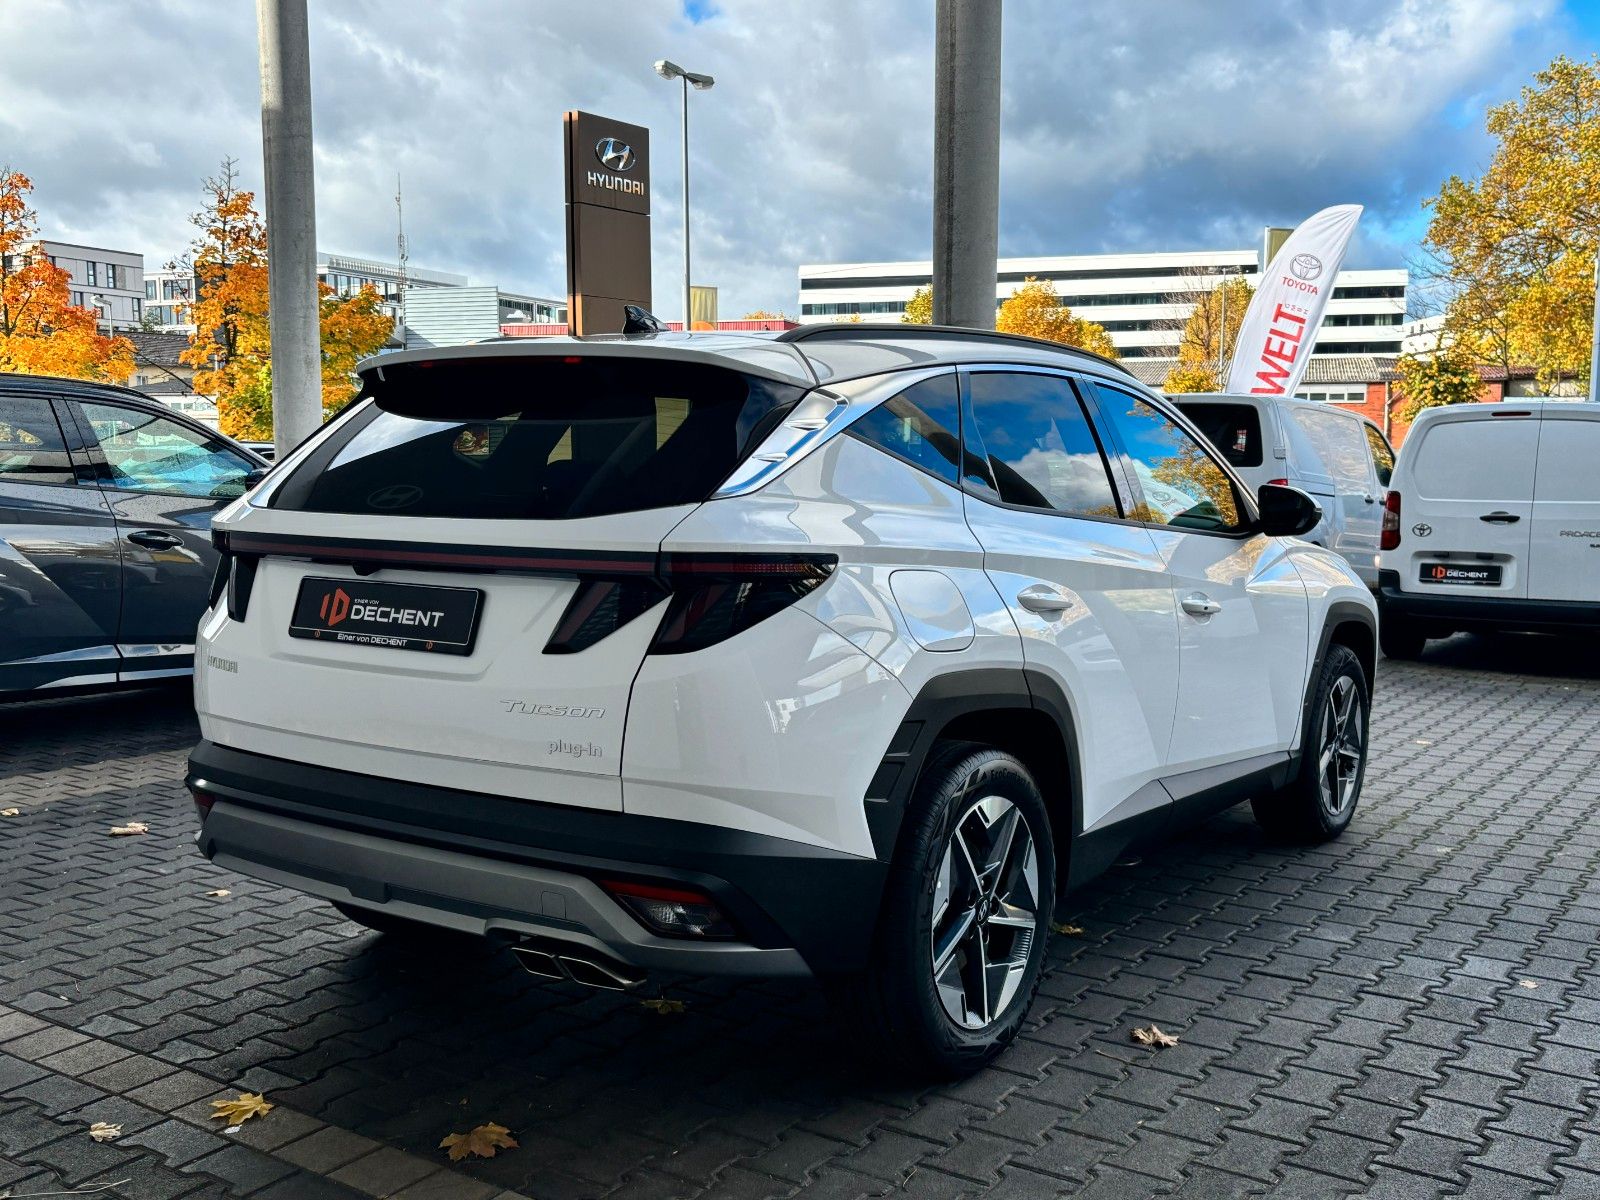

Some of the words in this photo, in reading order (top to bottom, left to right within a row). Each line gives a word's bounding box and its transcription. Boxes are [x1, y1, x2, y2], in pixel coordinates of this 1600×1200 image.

[587, 171, 644, 195] HYUNDAI
[1282, 277, 1318, 295] TOYOTA
[1250, 303, 1306, 394] WELT
[1446, 570, 1488, 578] DECHENT
[351, 605, 444, 627] DECHENT
[337, 633, 355, 641] Einer
[357, 634, 370, 643] von
[371, 636, 408, 647] DECHENT
[547, 739, 603, 758] plug-in
